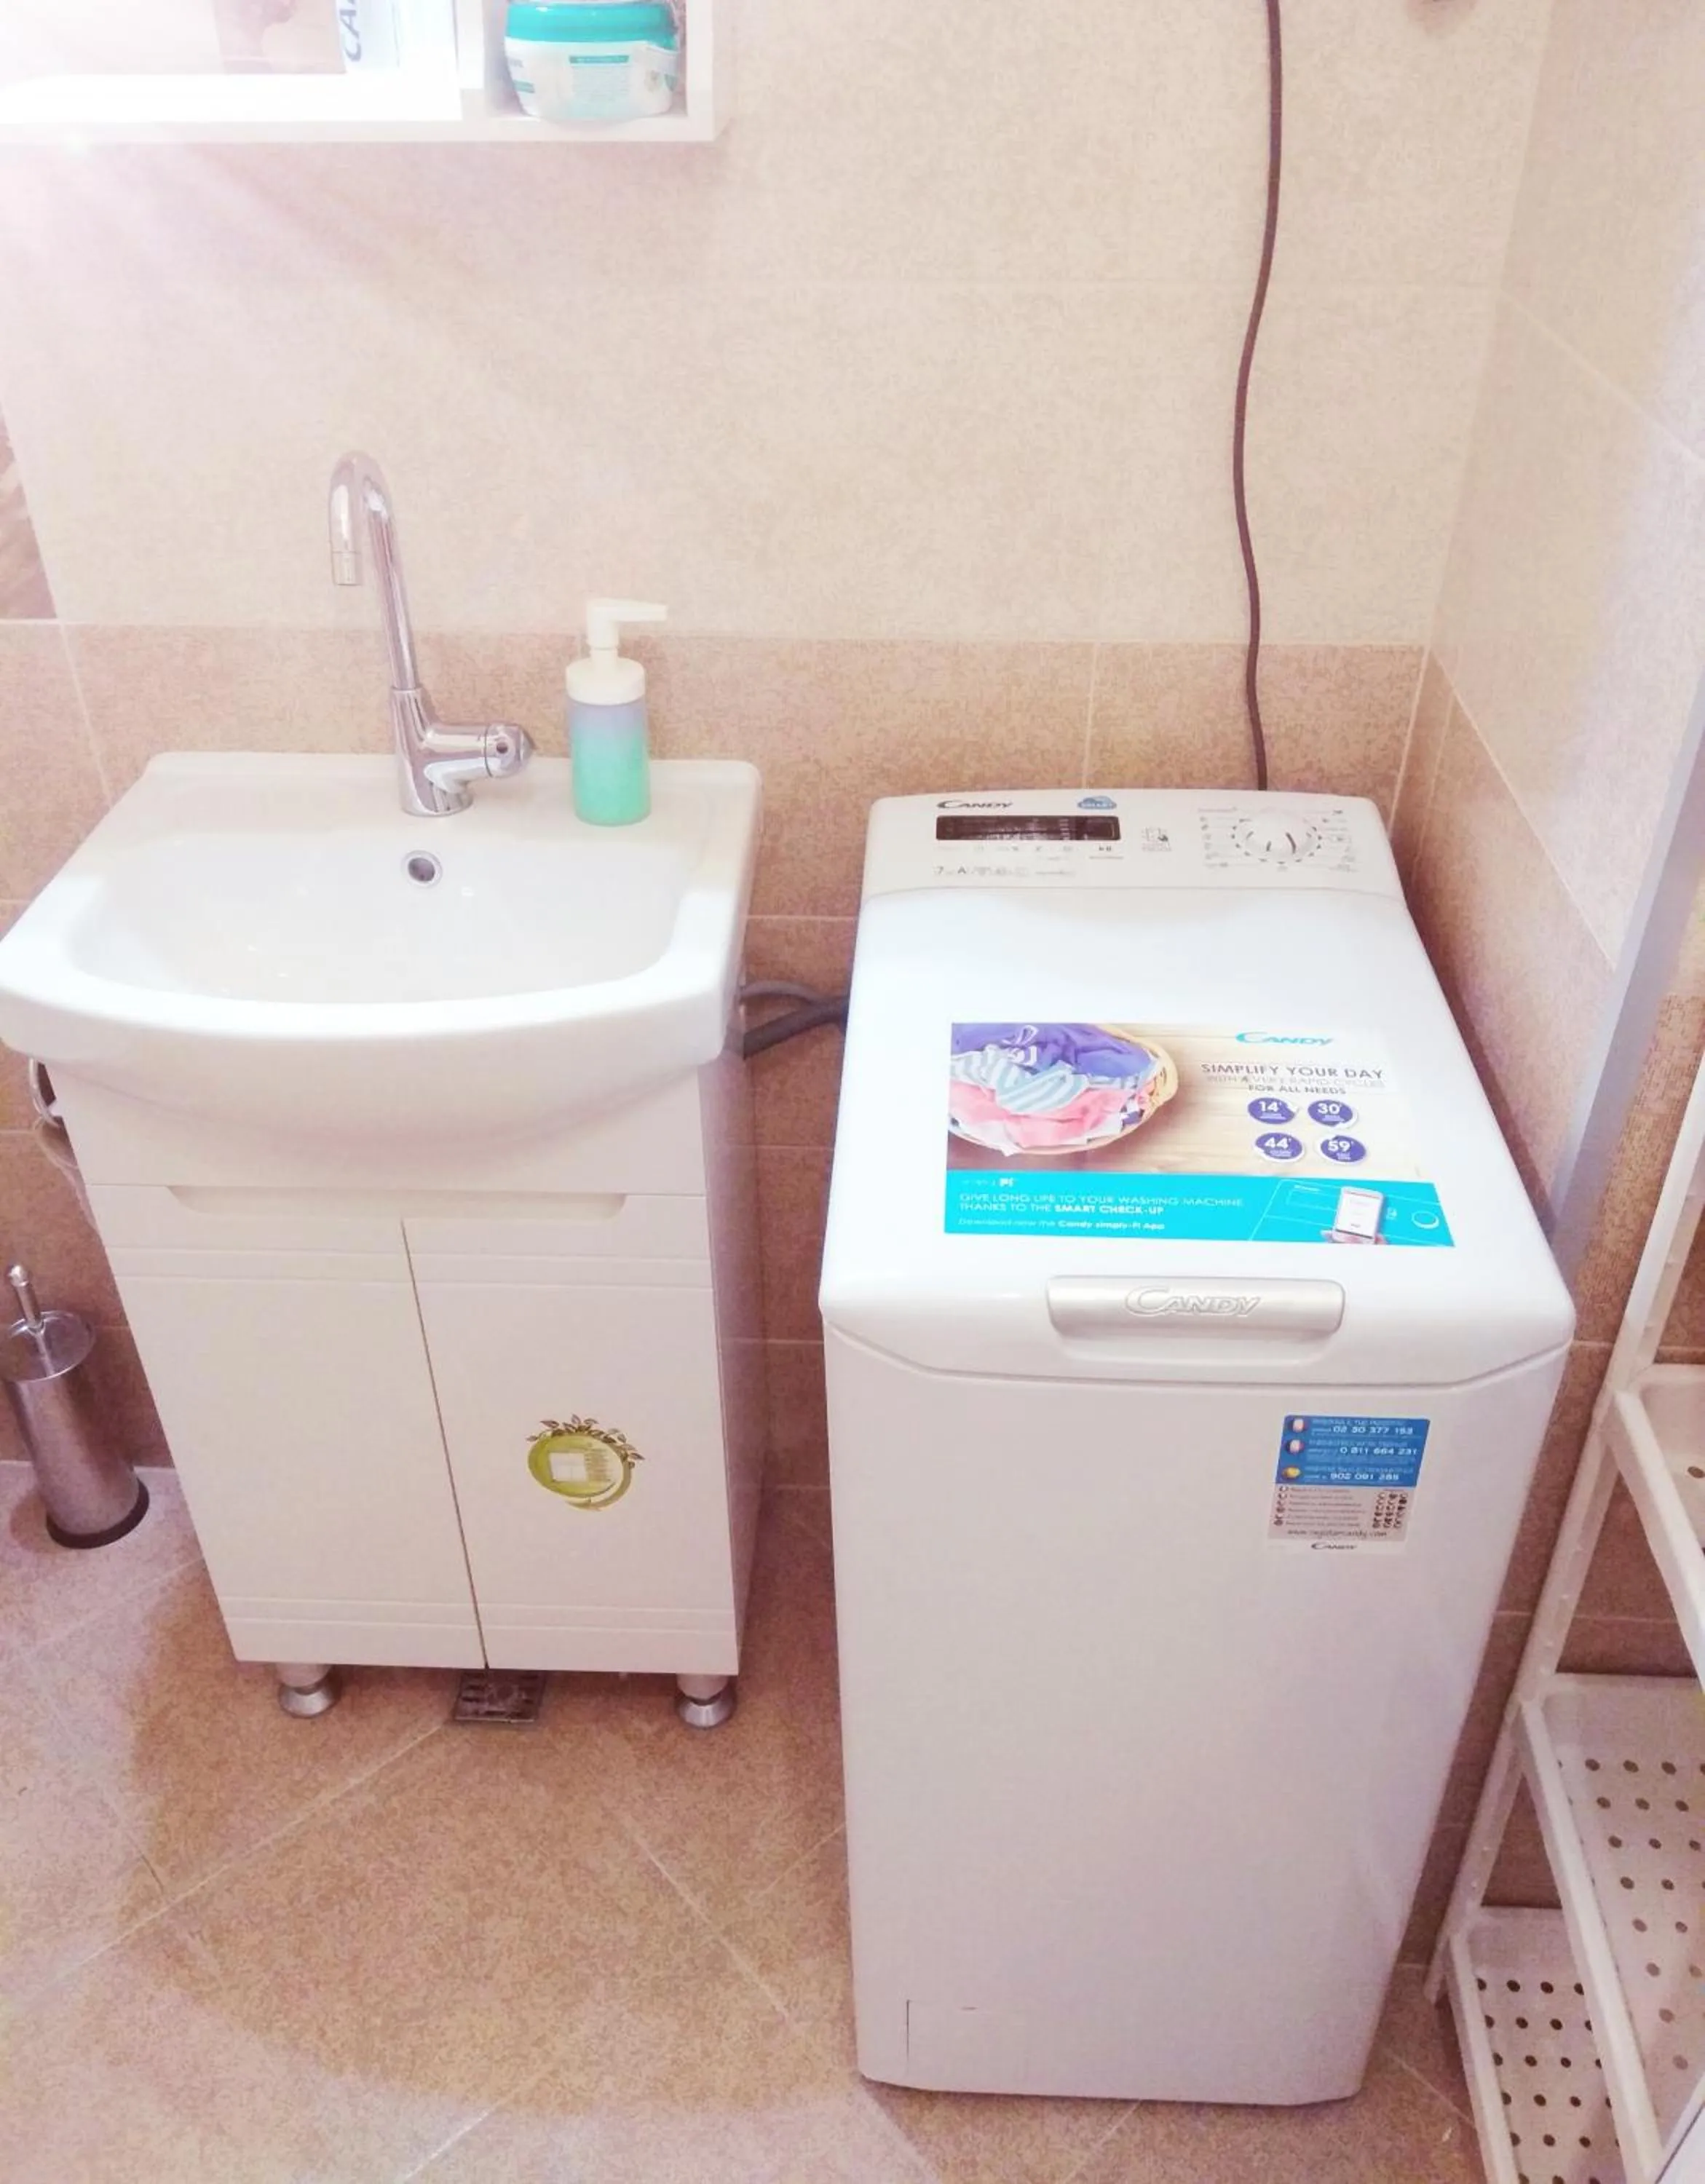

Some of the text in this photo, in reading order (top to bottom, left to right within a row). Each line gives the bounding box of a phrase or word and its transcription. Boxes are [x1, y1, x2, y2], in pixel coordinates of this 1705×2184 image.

[339, 0, 362, 62] CA
[936, 800, 1013, 810] CANDY
[1235, 1031, 1333, 1046] CANDY
[1200, 1063, 1384, 1080] SIMPLIFY YOUR DAY
[1248, 1084, 1347, 1095] FOR ALL NEEDS
[960, 1193, 1245, 1207] GIVE LONG LIFE TO YOUR WASHING MACHINE
[959, 1202, 1165, 1215] THANKS TO THE SMART CHECK-UP
[1057, 1220, 1093, 1229] Candy
[1125, 1285, 1262, 1317] CANDY
